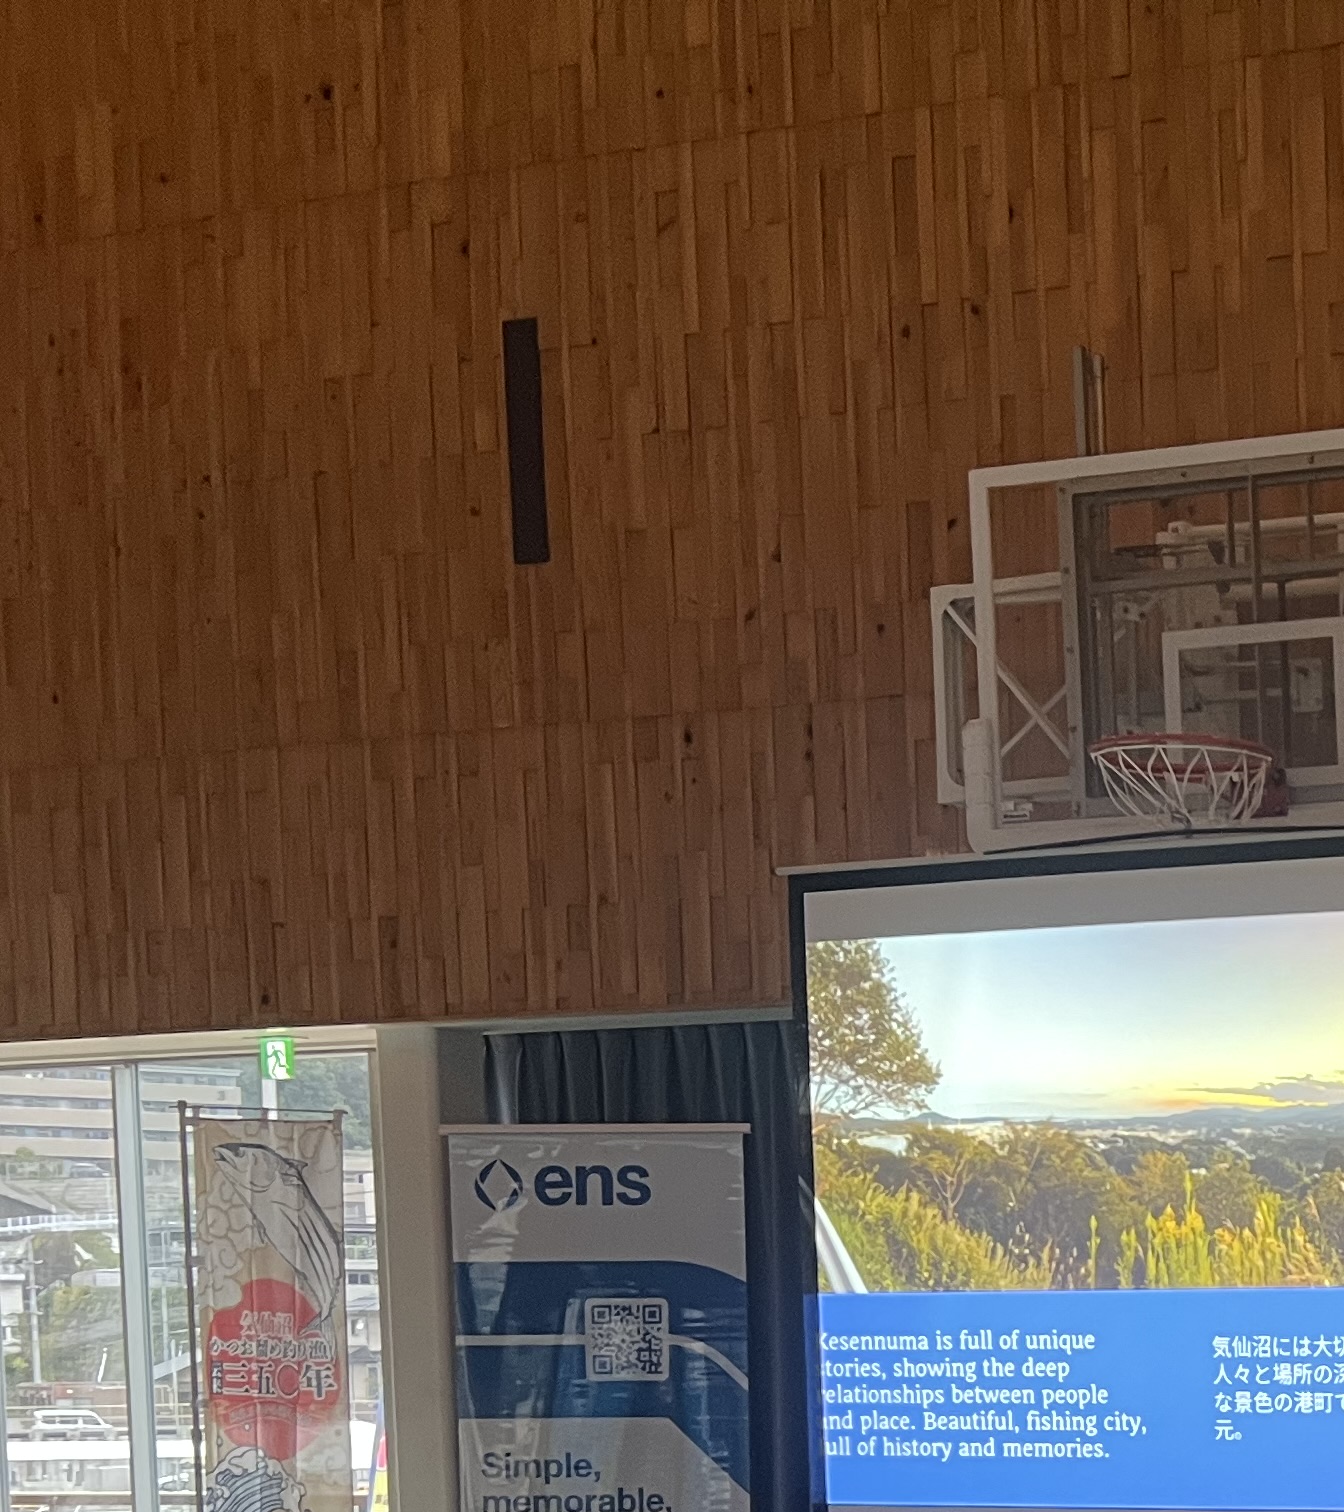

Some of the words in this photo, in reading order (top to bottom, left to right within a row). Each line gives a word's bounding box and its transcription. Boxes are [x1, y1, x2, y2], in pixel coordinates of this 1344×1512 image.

[534, 1165, 652, 1206] ens
[936, 1331, 953, 1350] is
[959, 1329, 993, 1350] full
[999, 1329, 1020, 1350] of
[1025, 1331, 1096, 1354] unique
[822, 1357, 887, 1380] tories,
[893, 1357, 976, 1382] showing
[982, 1357, 1015, 1377] the
[1021, 1357, 1070, 1382] deep
[951, 1384, 1034, 1405] between
[1042, 1384, 1108, 1409] people
[860, 1410, 916, 1435] place.
[923, 1410, 1020, 1434] Beautiful,
[1026, 1410, 1097, 1436] fishing
[1103, 1411, 1147, 1436] city,
[1214, 1419, 1242, 1441] 元。
[825, 1436, 850, 1456] ull
[857, 1435, 876, 1456] of
[883, 1436, 952, 1462] history
[959, 1437, 995, 1457] and
[1002, 1437, 1110, 1458] memories.
[481, 1452, 600, 1484] Simple,
